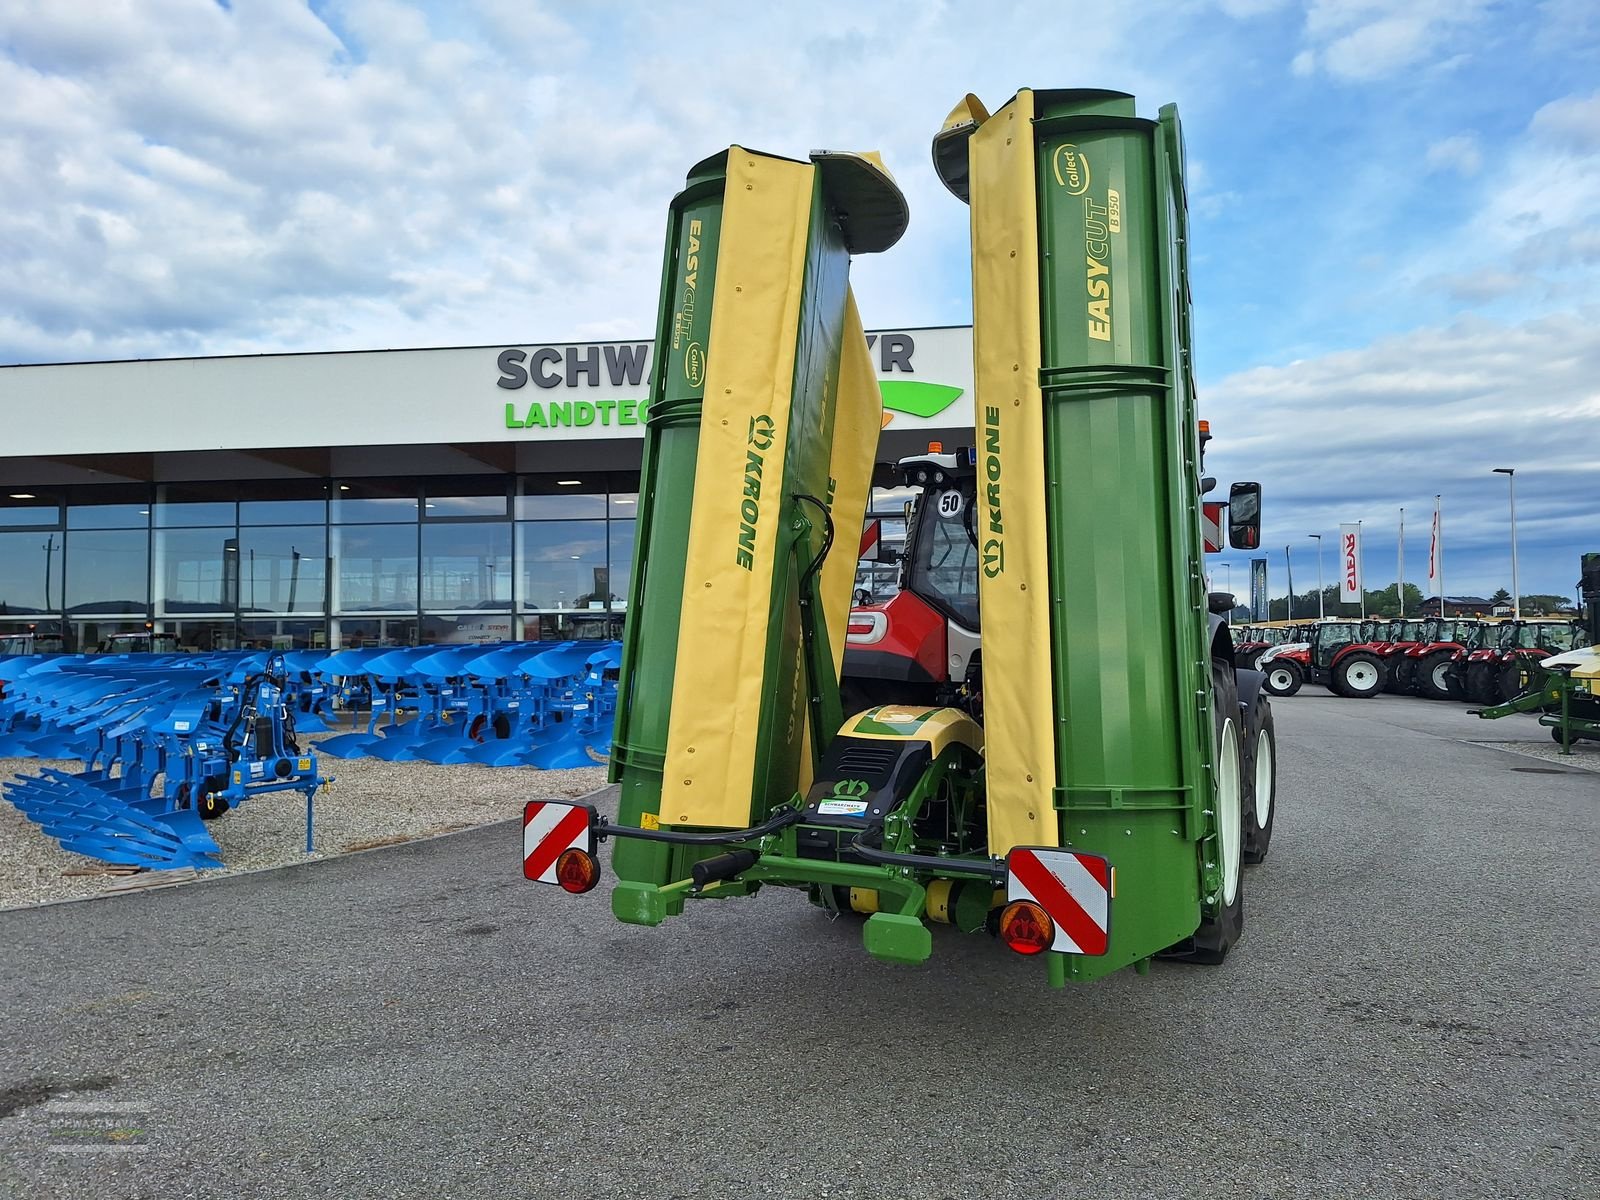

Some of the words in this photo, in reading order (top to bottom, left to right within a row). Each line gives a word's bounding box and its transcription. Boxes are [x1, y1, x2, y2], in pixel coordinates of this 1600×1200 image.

[1063, 151, 1081, 188] Collect
[1109, 195, 1120, 217] 950
[1110, 218, 1119, 227] B
[681, 219, 702, 341] EASYCUT
[1084, 197, 1111, 341] EASYCUT
[497, 344, 652, 390] SCHW
[986, 406, 1004, 534] KRONE
[737, 450, 765, 572] KRONE
[942, 495, 959, 513] 50
